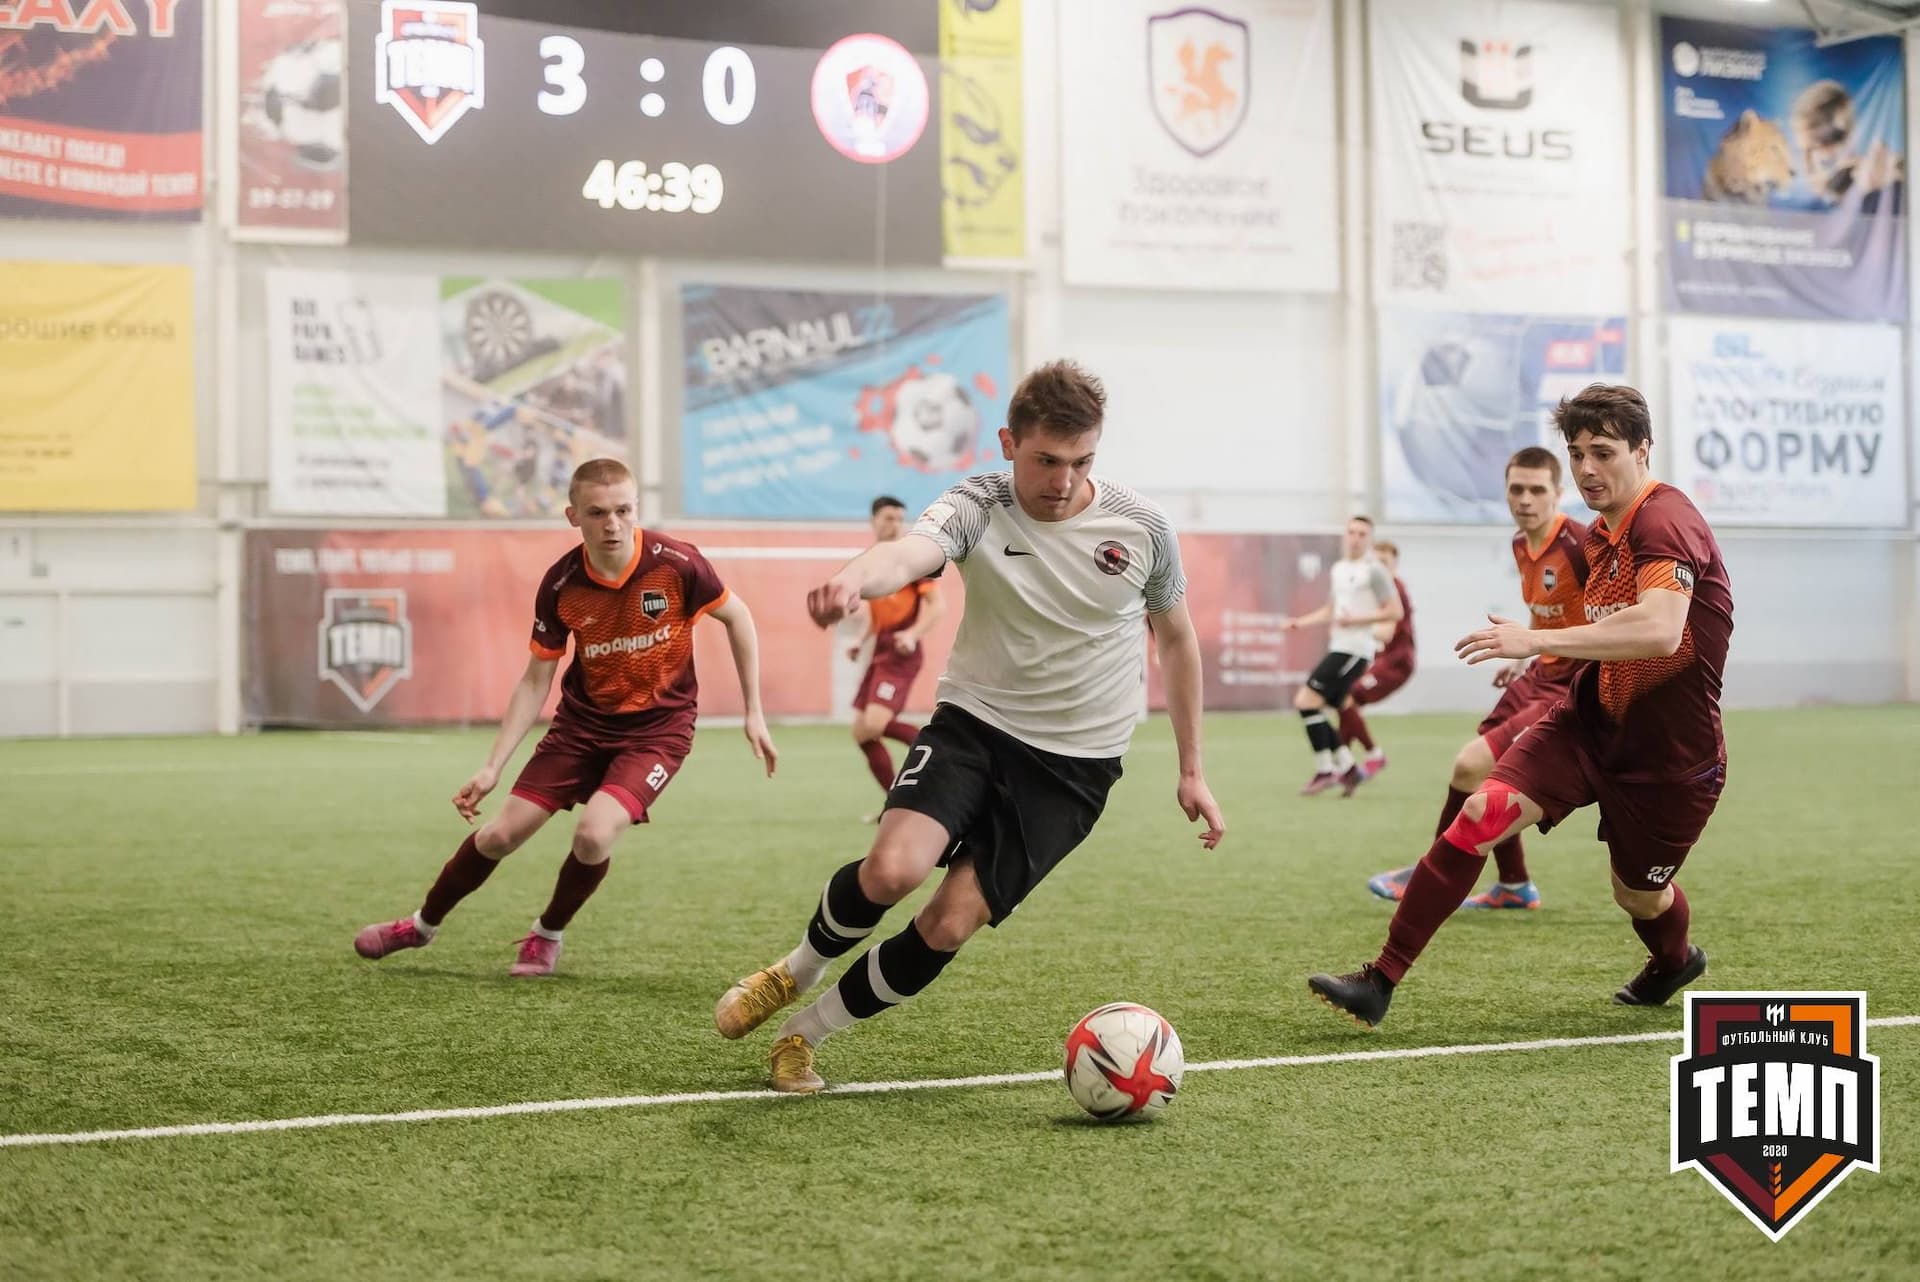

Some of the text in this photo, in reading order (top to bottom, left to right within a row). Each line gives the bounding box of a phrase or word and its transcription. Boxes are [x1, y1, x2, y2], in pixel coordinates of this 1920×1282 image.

[537, 35, 587, 115] 3
[702, 46, 756, 125] 0
[1421, 120, 1573, 161] SEUS
[582, 159, 724, 213] 46:39
[1695, 427, 1882, 475] ФОРМУ
[1648, 865, 1675, 883] 23
